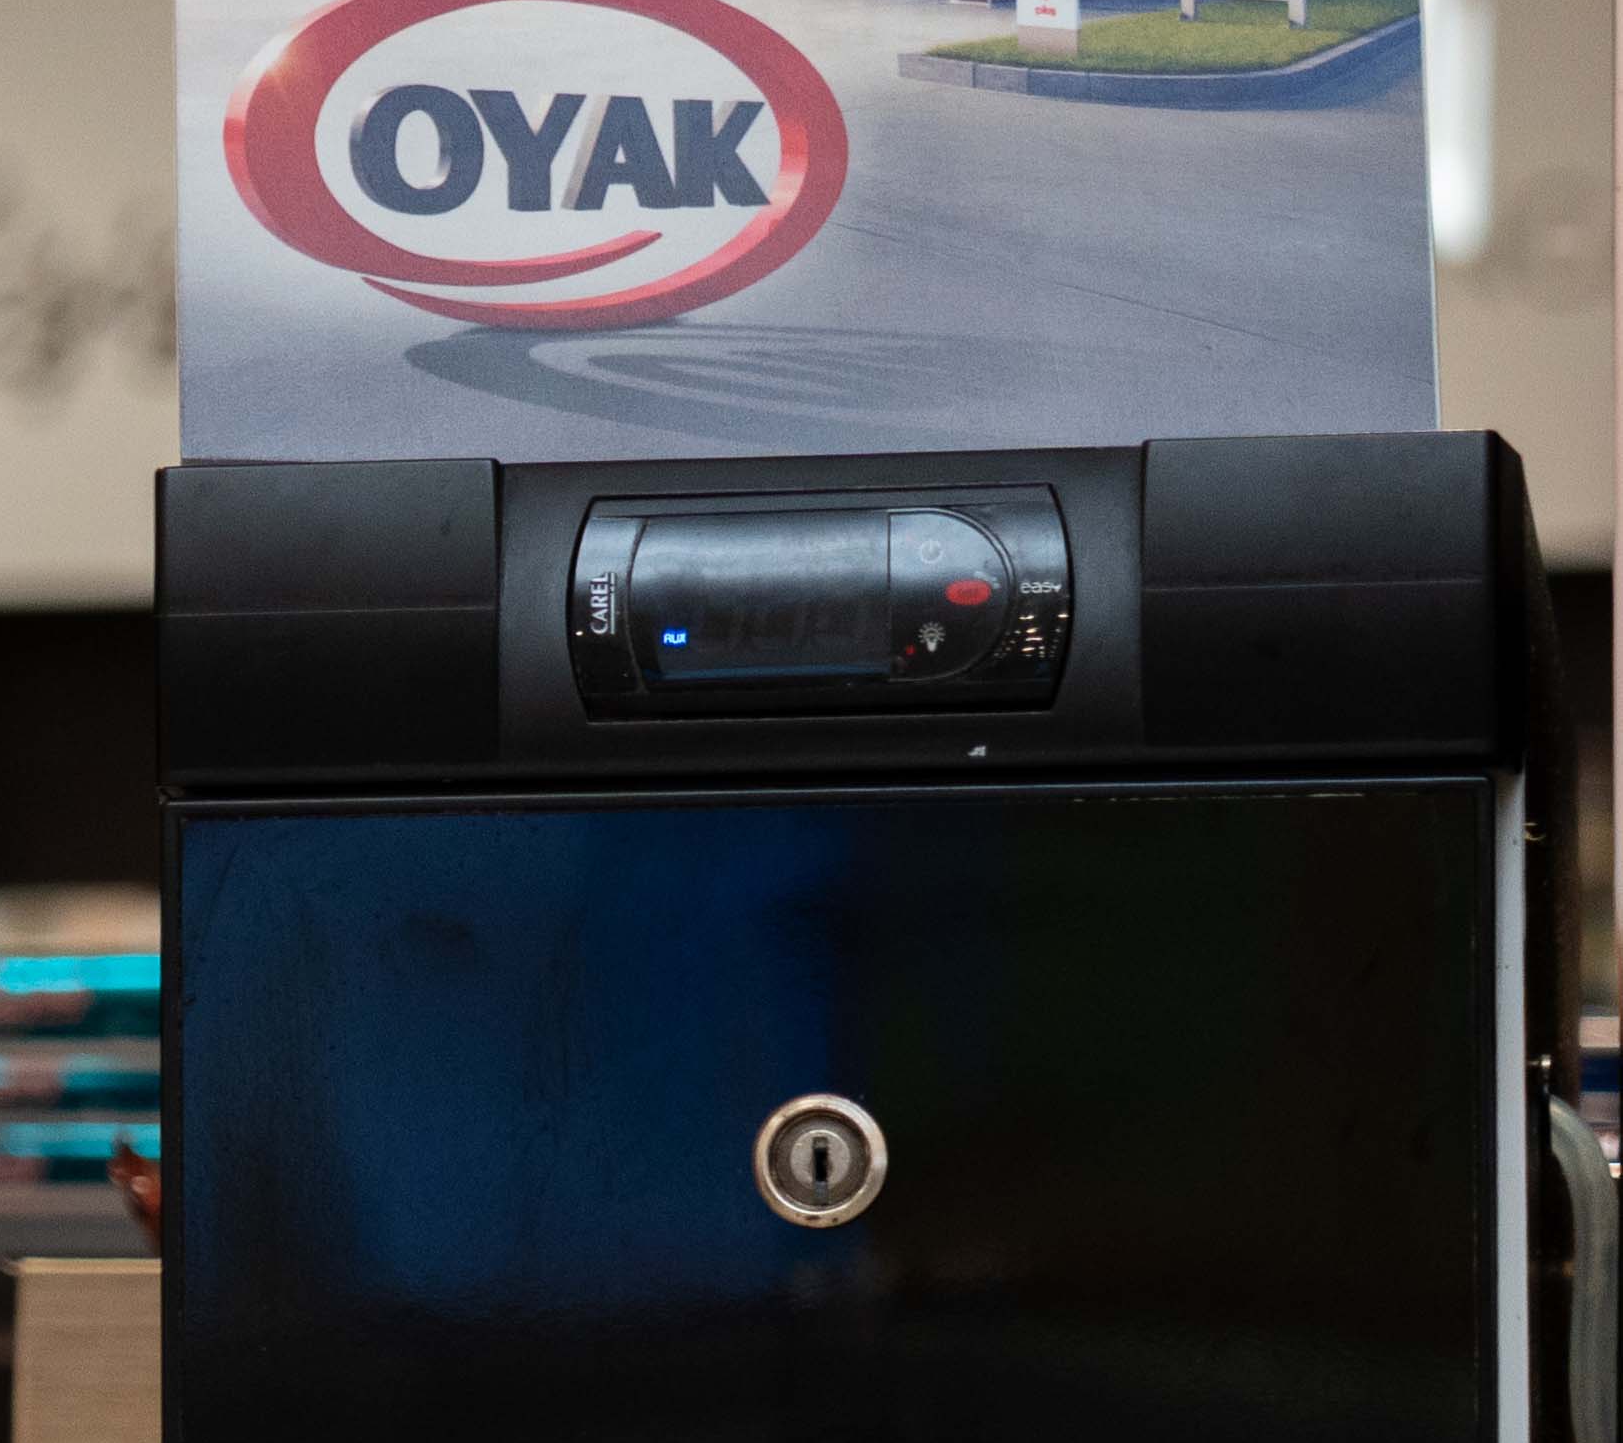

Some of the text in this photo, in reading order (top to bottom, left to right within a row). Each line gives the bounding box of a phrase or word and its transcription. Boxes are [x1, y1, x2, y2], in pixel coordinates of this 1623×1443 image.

[349, 83, 772, 215] OYAK
[590, 572, 610, 636] CAREL
[1020, 581, 1062, 594] easy
